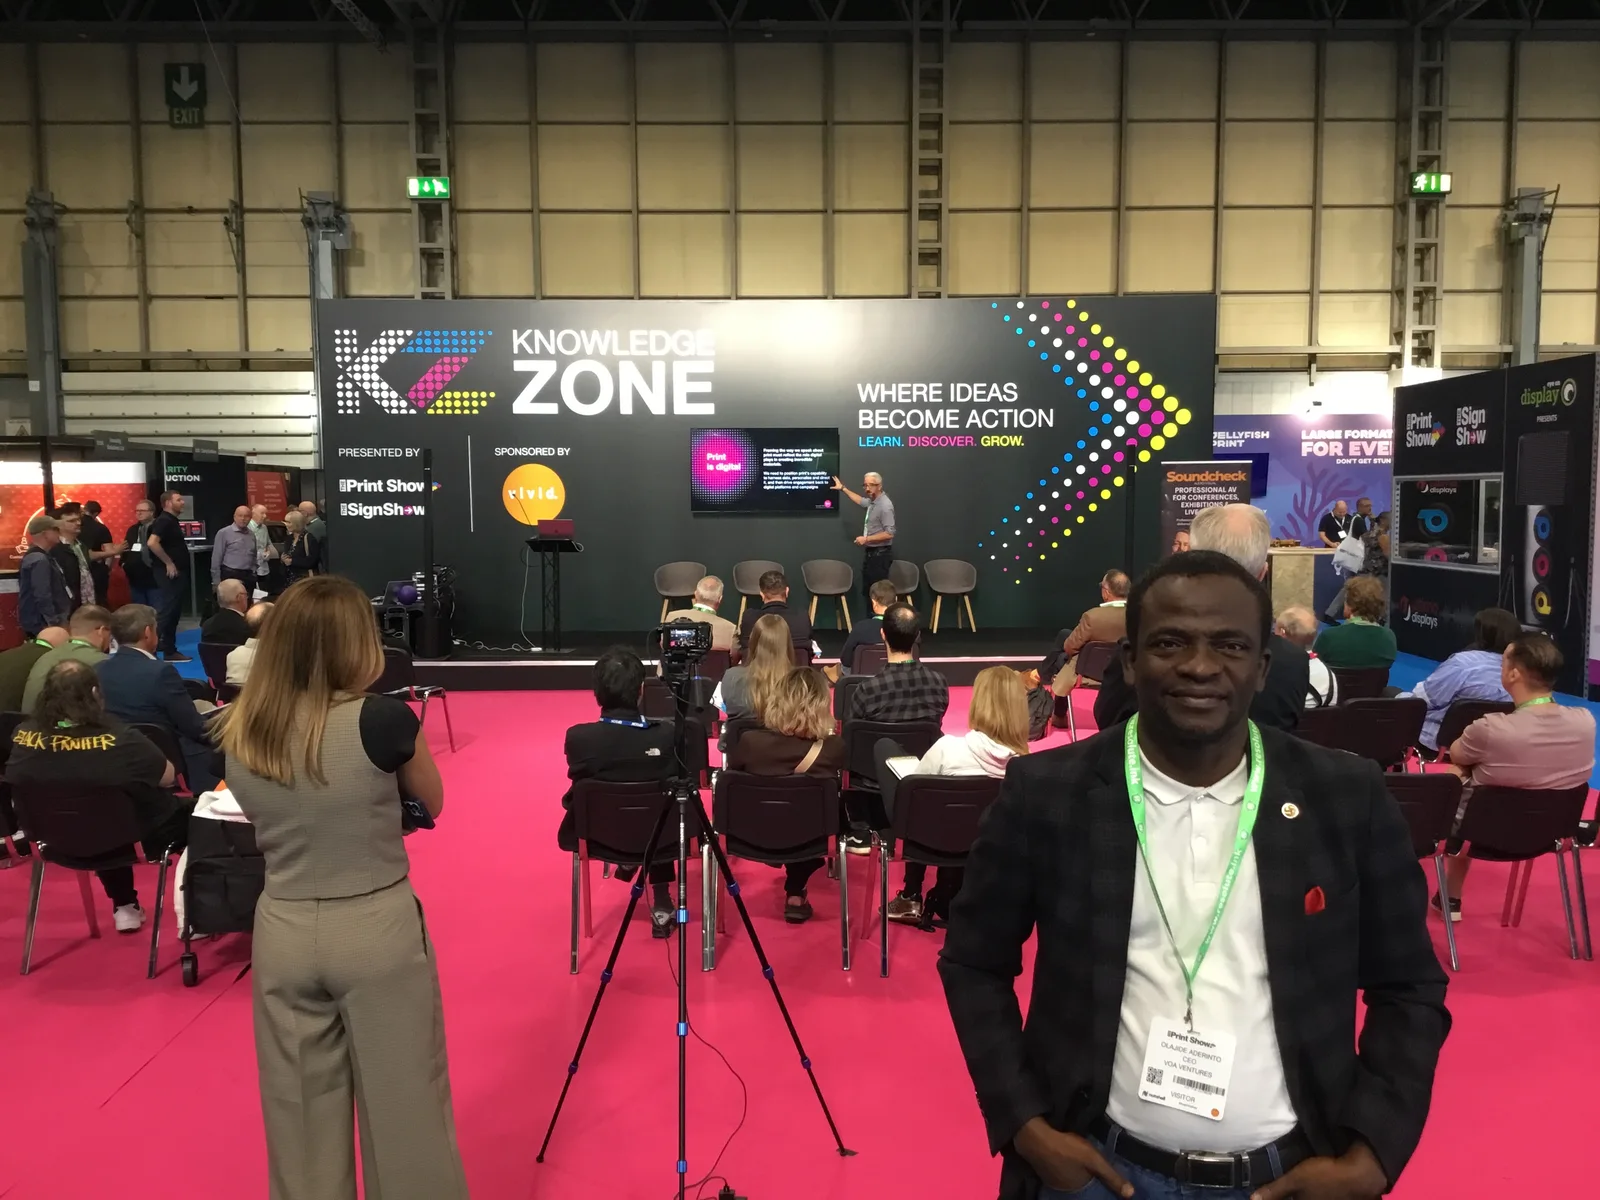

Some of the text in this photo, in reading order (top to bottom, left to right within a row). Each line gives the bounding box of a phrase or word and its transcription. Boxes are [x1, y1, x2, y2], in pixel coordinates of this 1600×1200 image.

[174, 108, 200, 124] EXIT
[512, 329, 715, 356] KNOWLEDGE
[512, 360, 715, 416] ZONE
[857, 383, 1018, 402] WHERE IDEAS
[1520, 386, 1559, 408] display
[858, 408, 1054, 428] BECOME ACTION
[1411, 412, 1432, 430] Print
[1462, 406, 1486, 429] Sign
[1536, 414, 1558, 422] PRESENTS
[858, 436, 1024, 447] LEARN. DISCOVER. GROW.
[1213, 431, 1270, 440] JELLYFISH
[1302, 428, 1393, 440] LARGE FORMAT
[1406, 430, 1432, 448] Show
[338, 448, 420, 458] PRESENTED BY
[494, 448, 570, 456] SPONSORED BY
[1302, 440, 1392, 456] FOR EVE
[716, 462, 741, 472] digital
[1166, 470, 1246, 482] Soundcheck
[346, 479, 384, 492] Print
[386, 479, 424, 492] Show
[1412, 612, 1438, 630] displays
[1170, 1031, 1188, 1042] Print
[1190, 1036, 1212, 1048] Show
[1161, 1042, 1222, 1062] OLAJIDE ADERINTO
[1182, 1056, 1197, 1064] CEO
[1164, 1060, 1212, 1078] VOA VENTURES
[1170, 1091, 1196, 1102] VISITOR
